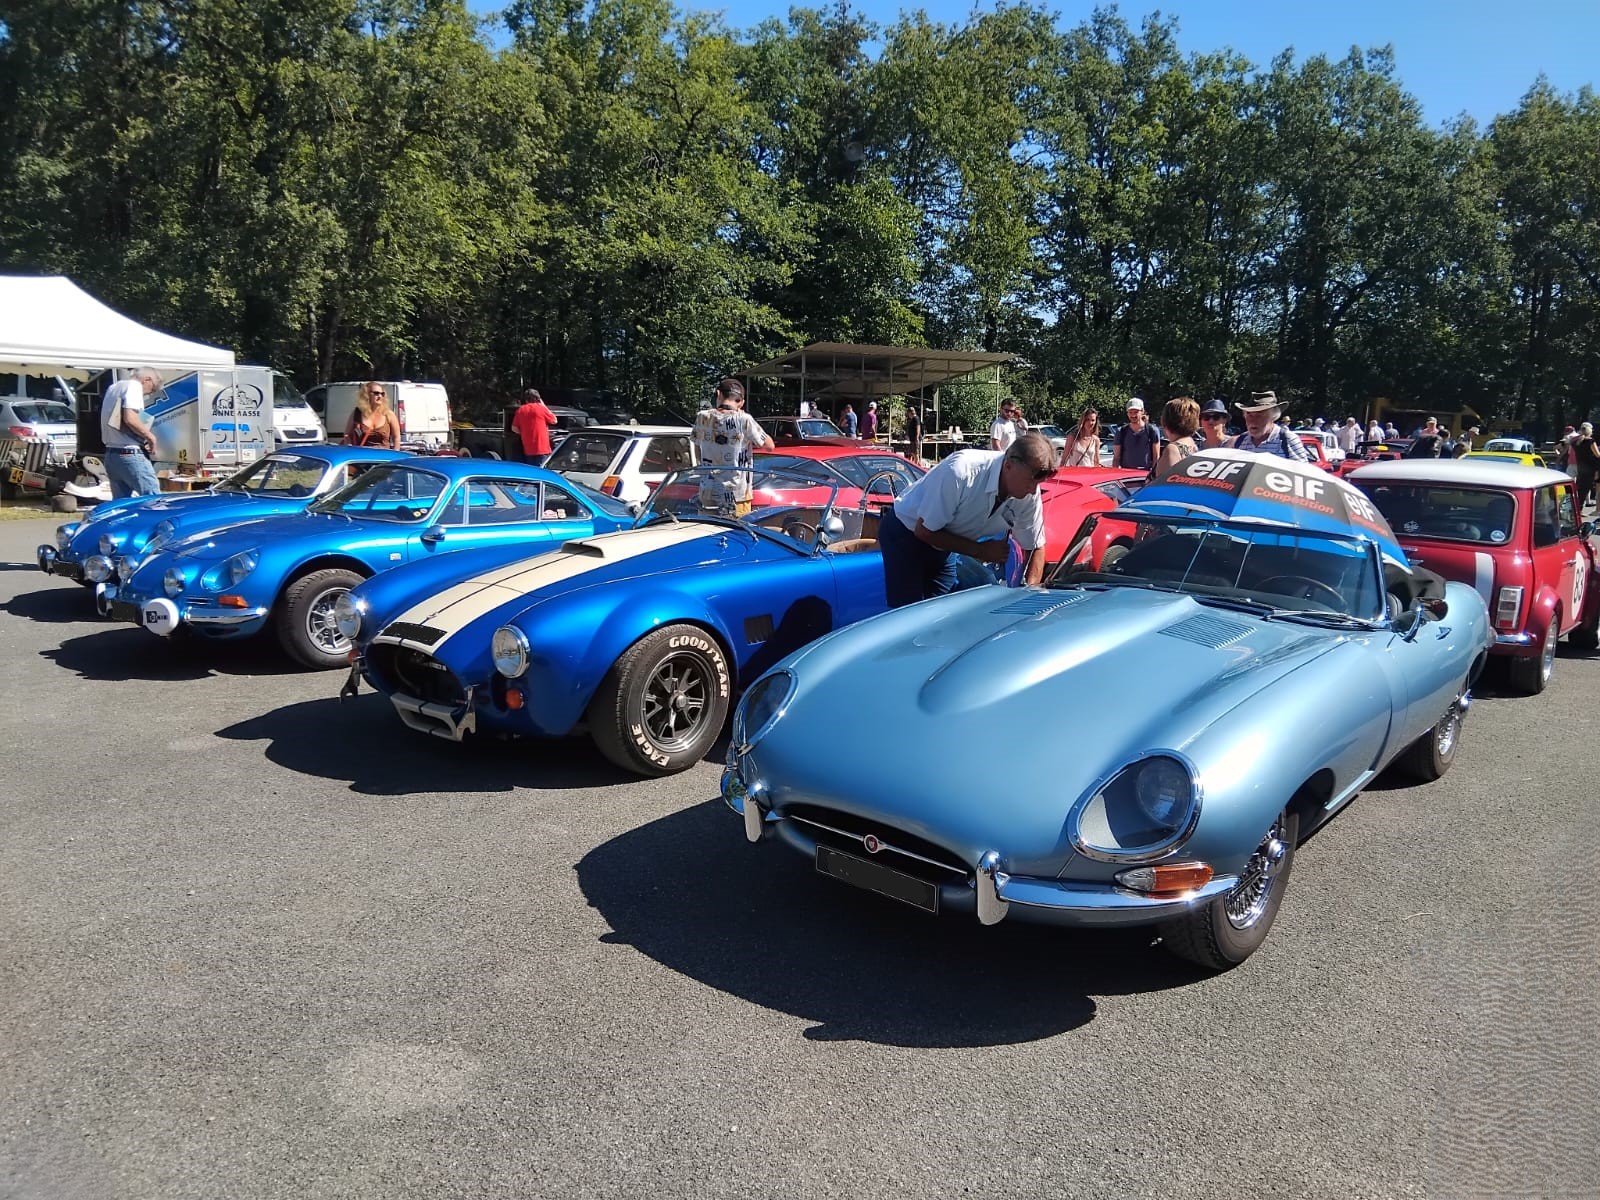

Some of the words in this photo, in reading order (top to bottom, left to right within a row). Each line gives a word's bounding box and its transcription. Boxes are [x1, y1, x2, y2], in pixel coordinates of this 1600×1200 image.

[725, 418, 737, 431] HA
[1186, 460, 1247, 480] elf
[1265, 472, 1324, 501] elf
[1345, 492, 1375, 521] elf
[631, 723, 671, 767] EAGLE
